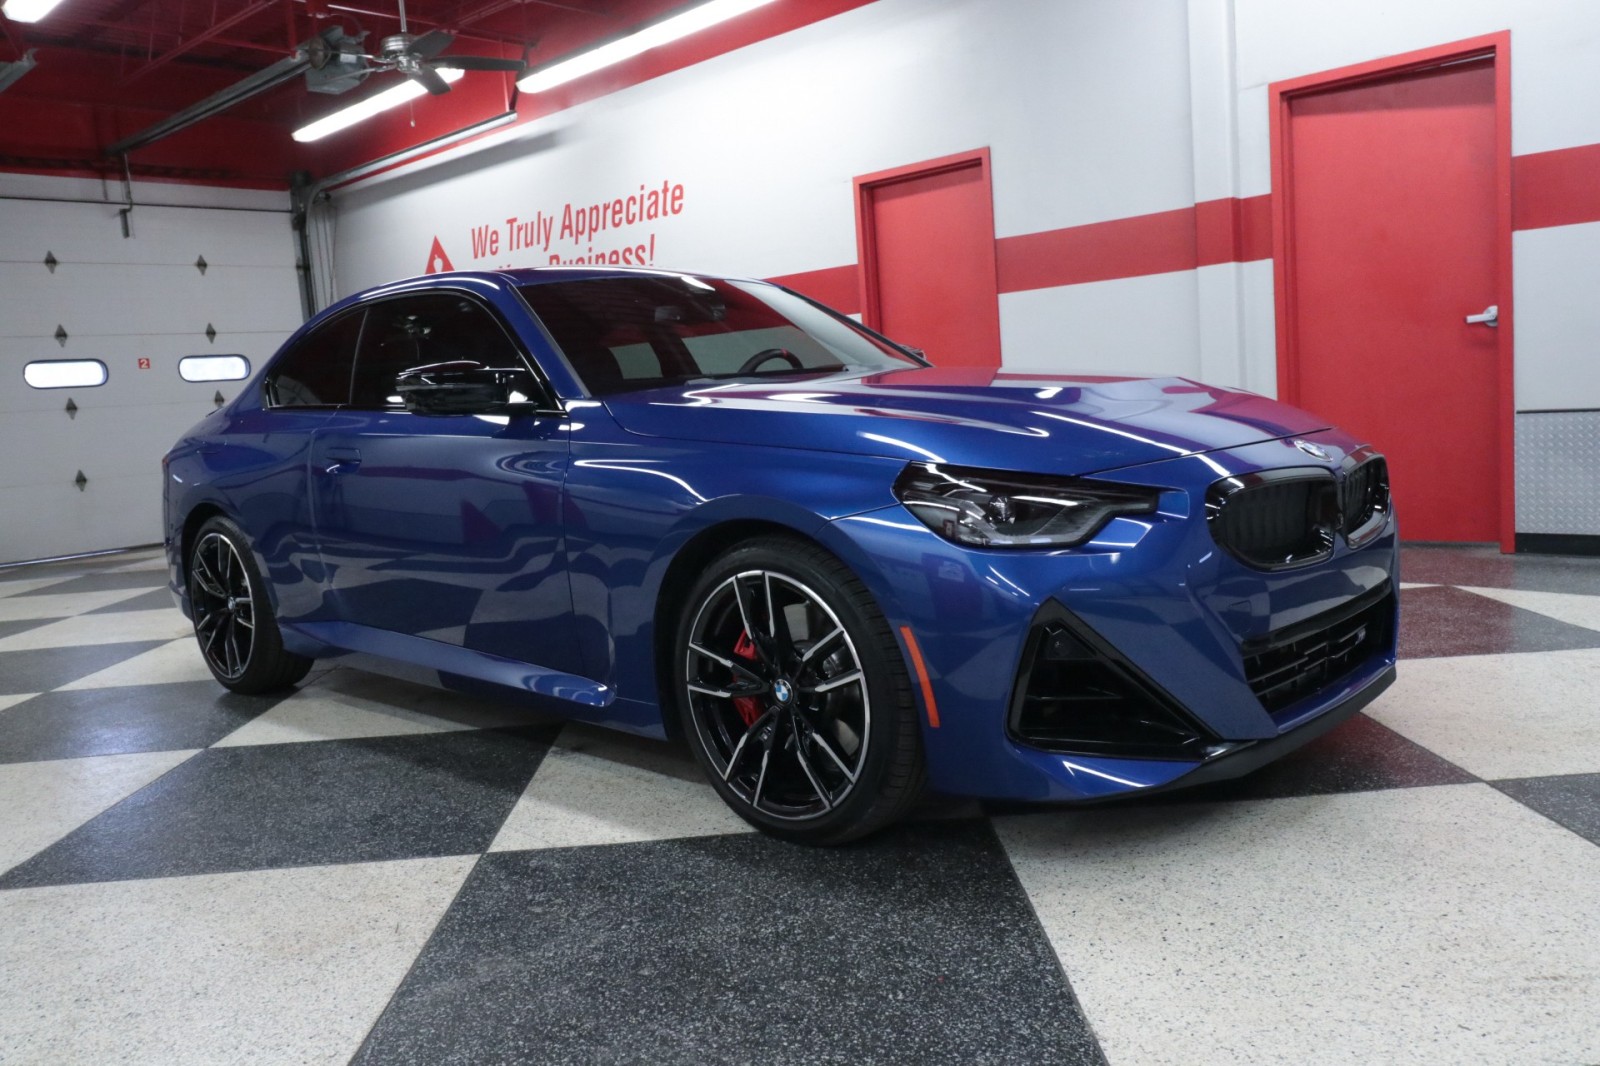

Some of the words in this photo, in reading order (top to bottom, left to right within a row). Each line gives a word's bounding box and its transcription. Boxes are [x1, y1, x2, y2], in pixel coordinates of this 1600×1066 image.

[471, 226, 500, 259] We
[505, 211, 554, 252] Truly
[559, 180, 685, 245] Appreciate
